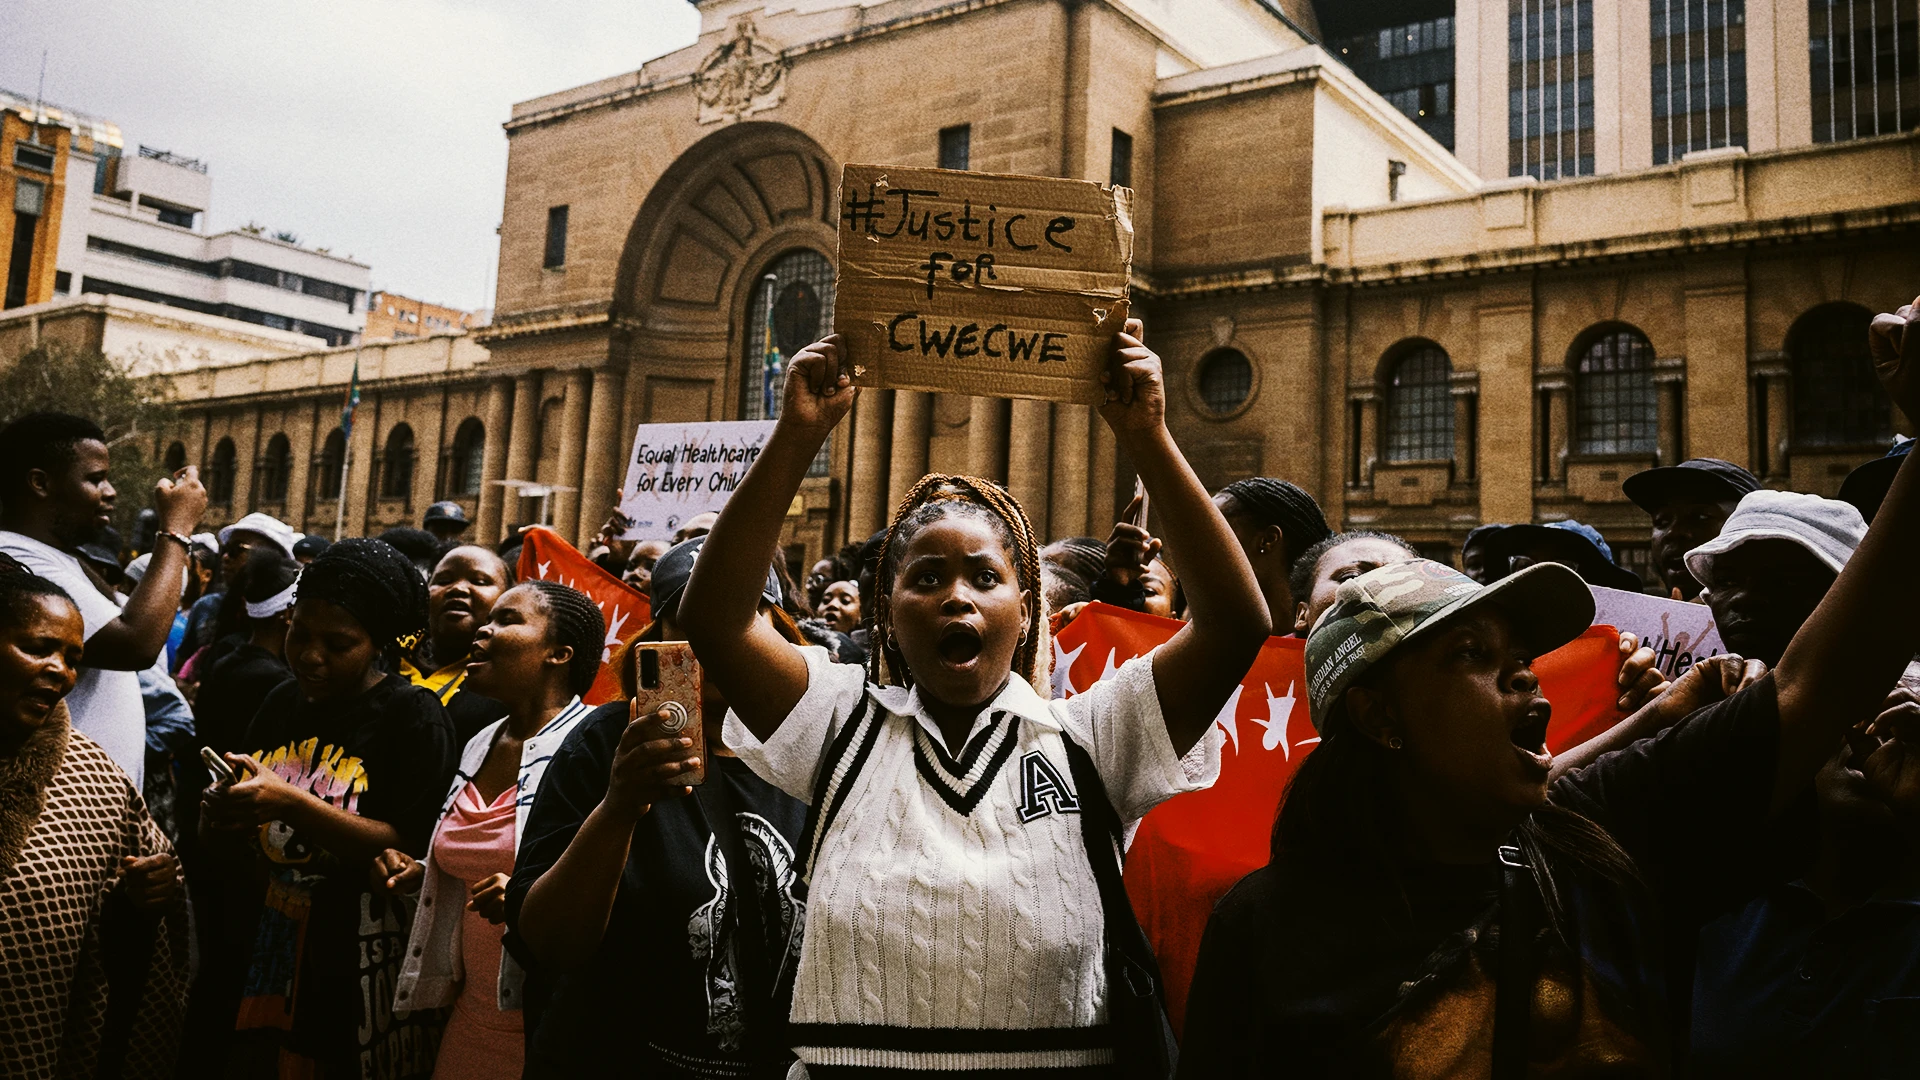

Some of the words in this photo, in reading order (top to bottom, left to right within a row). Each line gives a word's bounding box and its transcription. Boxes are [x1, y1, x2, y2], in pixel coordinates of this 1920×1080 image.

[842, 184, 1076, 253] #Justice
[888, 311, 1069, 363] CWECWE
[637, 444, 678, 465] Equal
[680, 443, 761, 463] Healthcare
[637, 472, 659, 492] for
[661, 471, 704, 493] Every
[1329, 659, 1348, 683] MARINE
[1347, 644, 1366, 664] TRUST
[1334, 632, 1362, 663] ANGEL
[1016, 750, 1082, 824] A
